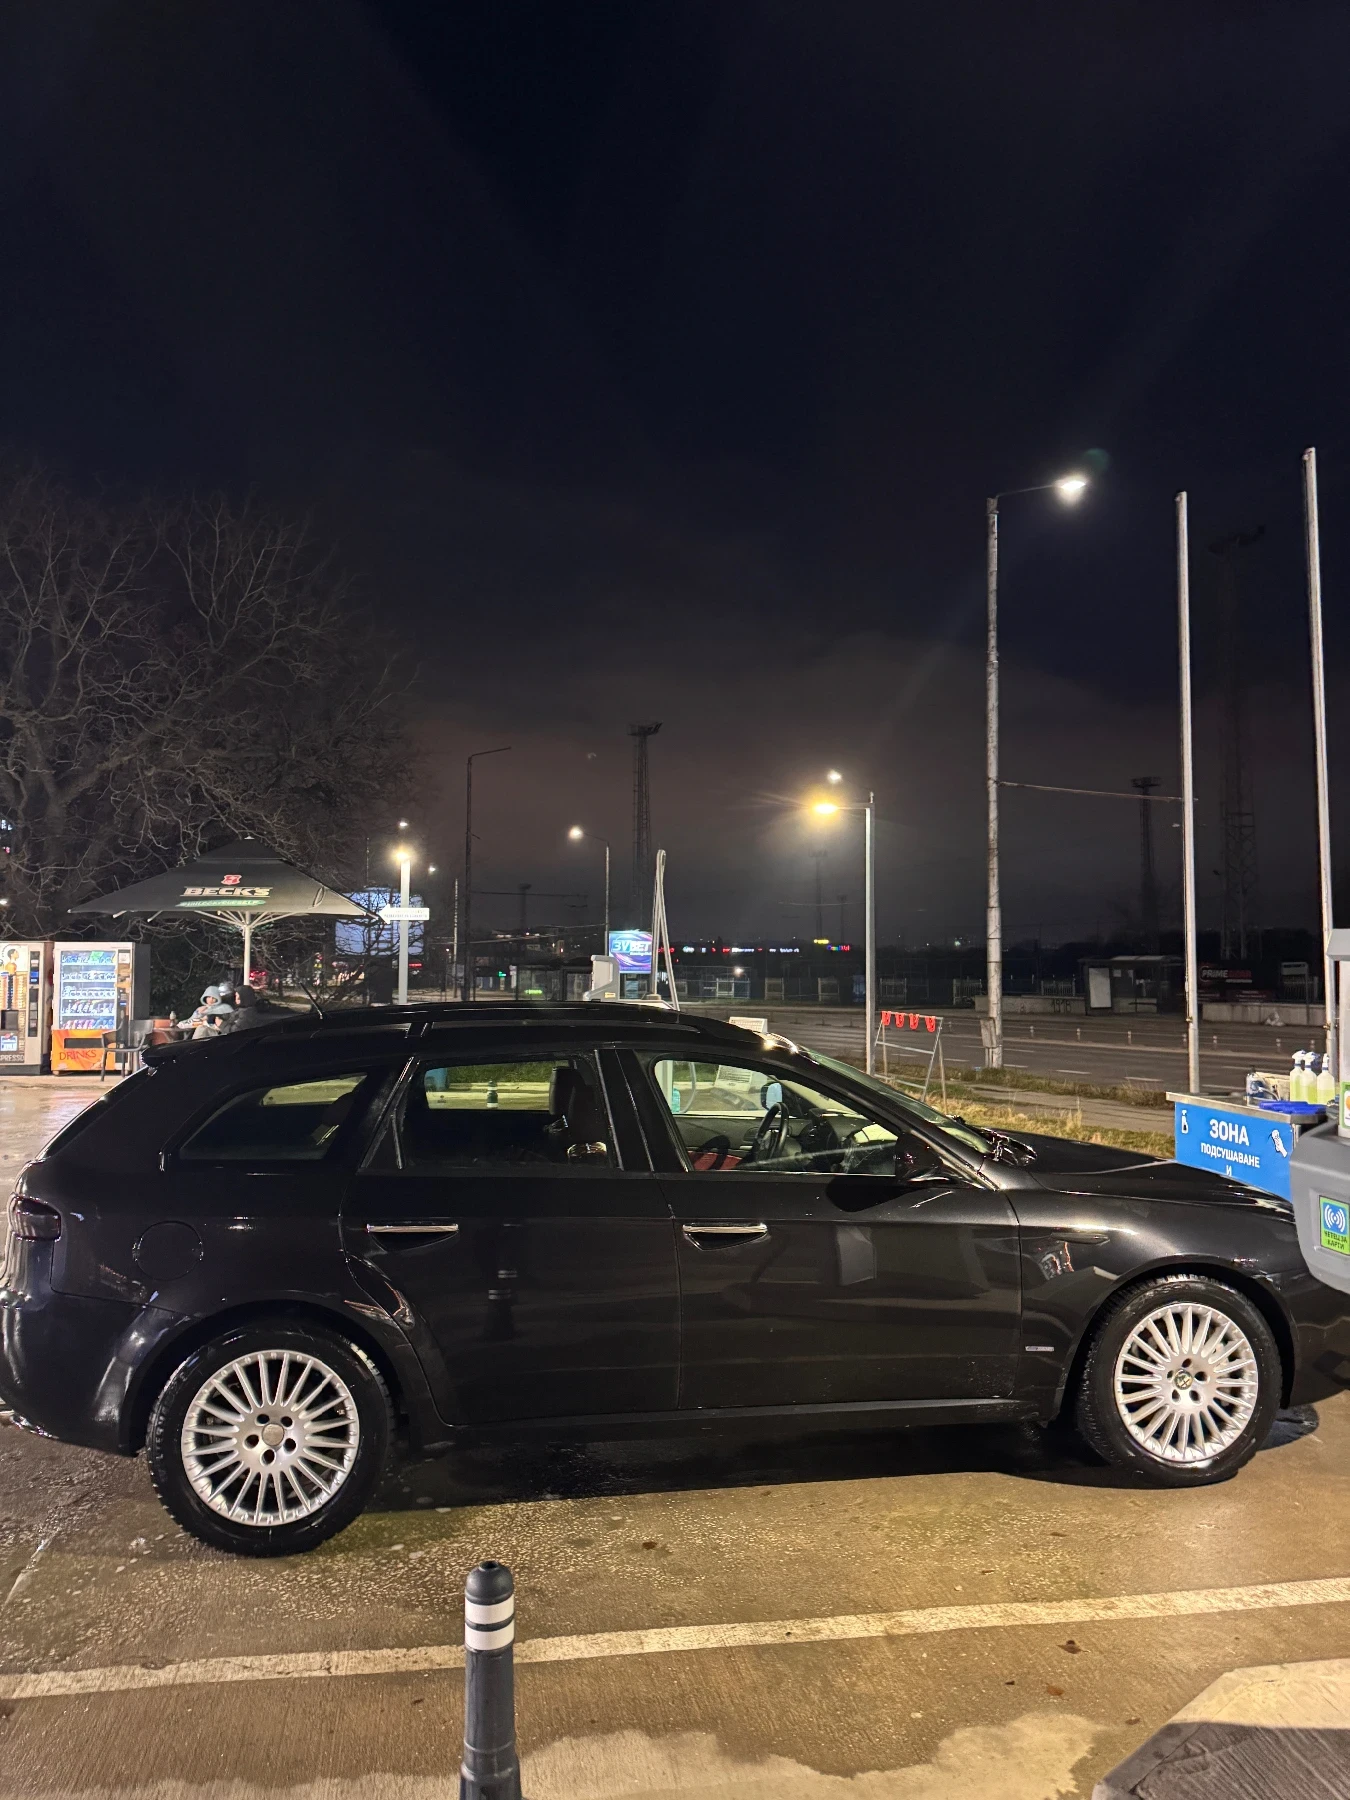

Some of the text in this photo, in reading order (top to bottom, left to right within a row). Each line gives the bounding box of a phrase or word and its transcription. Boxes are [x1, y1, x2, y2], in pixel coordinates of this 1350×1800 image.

[0, 1054, 24, 1063] PRESSO
[60, 1050, 97, 1061] DRINKS
[1210, 1118, 1249, 1146] ЗОНА
[1200, 1142, 1260, 1168] ПОДСУШАВАНЕ
